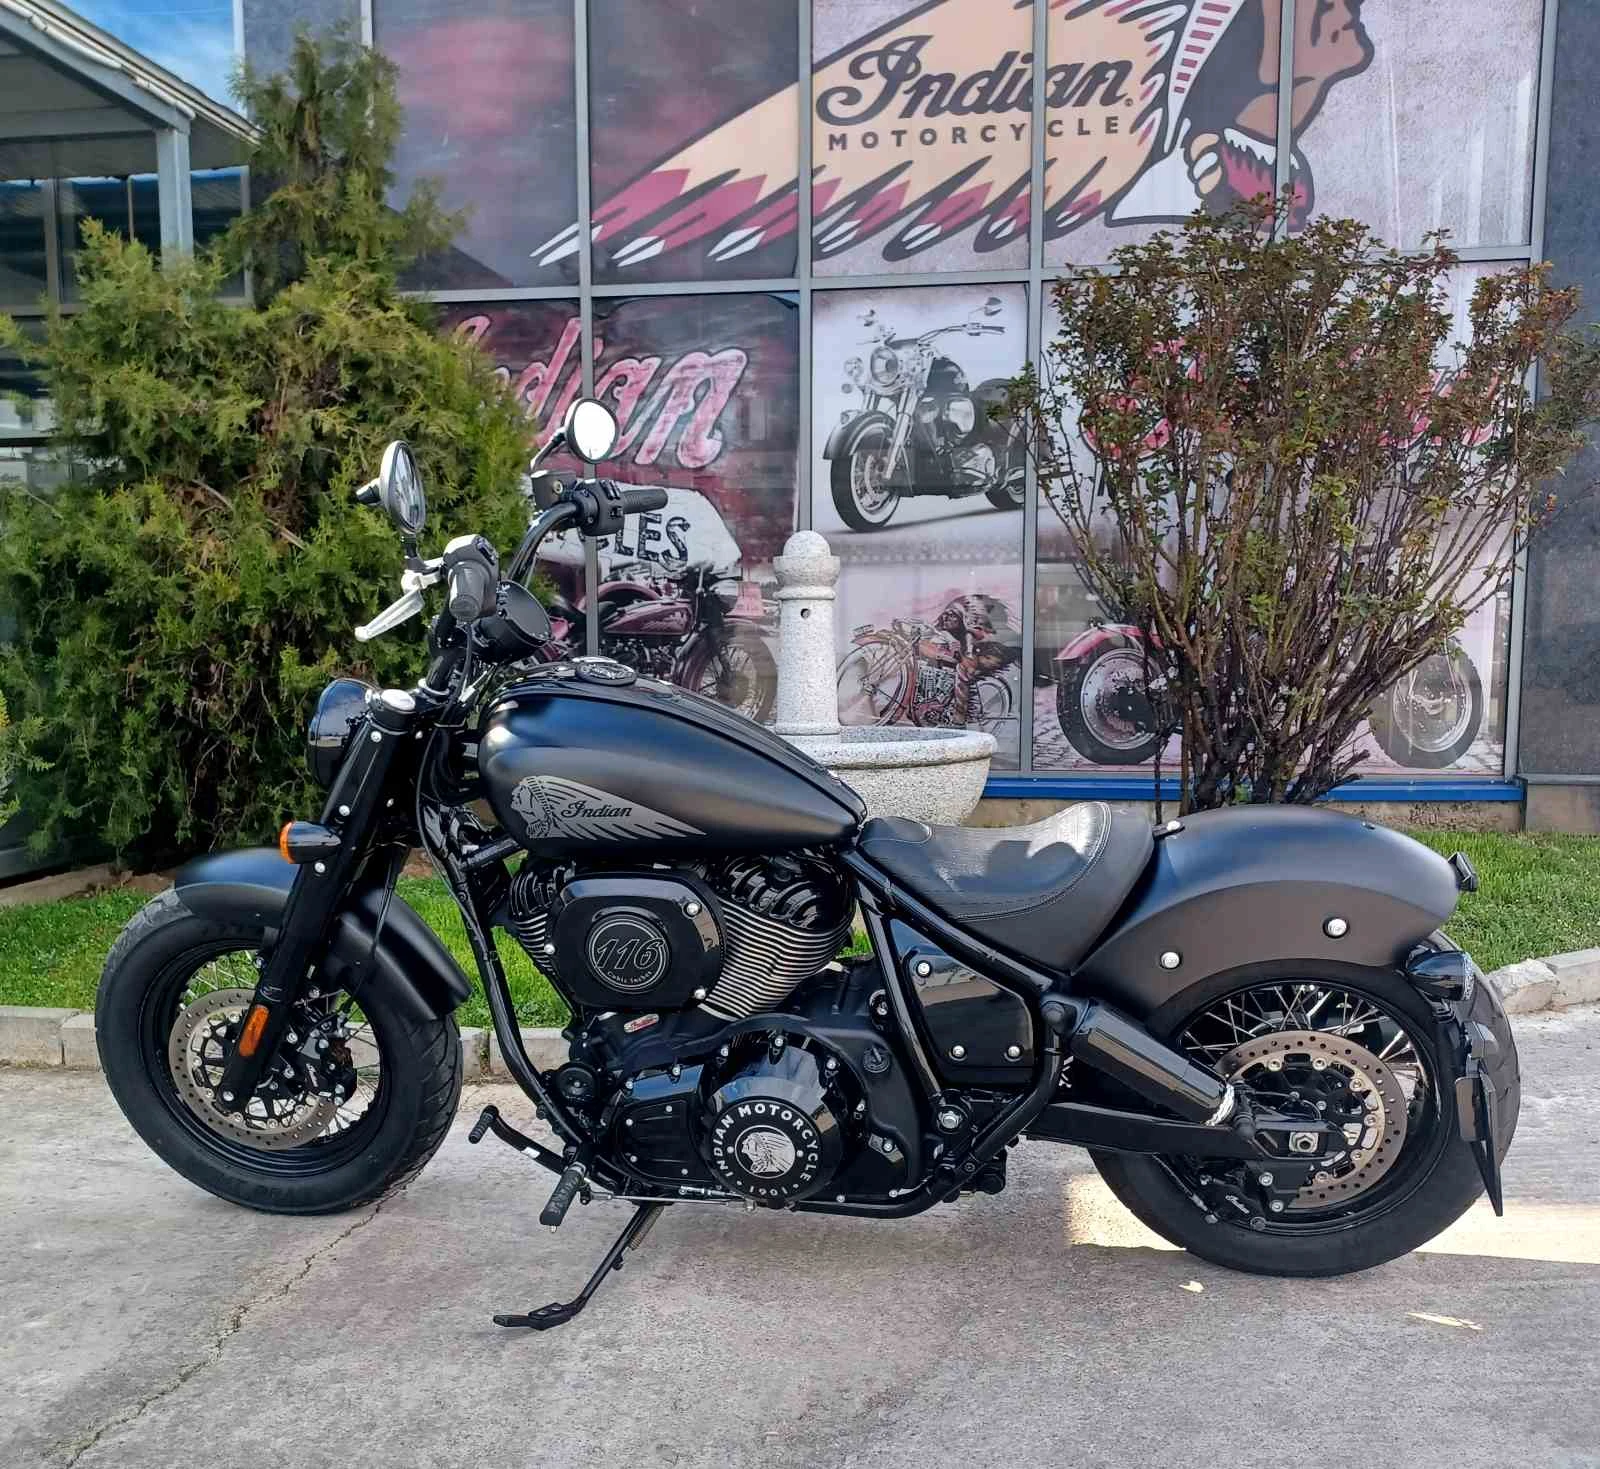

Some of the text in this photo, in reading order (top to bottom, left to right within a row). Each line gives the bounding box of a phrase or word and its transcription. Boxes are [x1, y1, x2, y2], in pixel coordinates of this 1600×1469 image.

[815, 35, 1132, 126] Indian
[828, 116, 1119, 151] MOTORCYCLE
[561, 800, 632, 818] Indian
[597, 938, 665, 969] 116
[713, 1103, 819, 1181] INDIAN MOTORCYCLE
